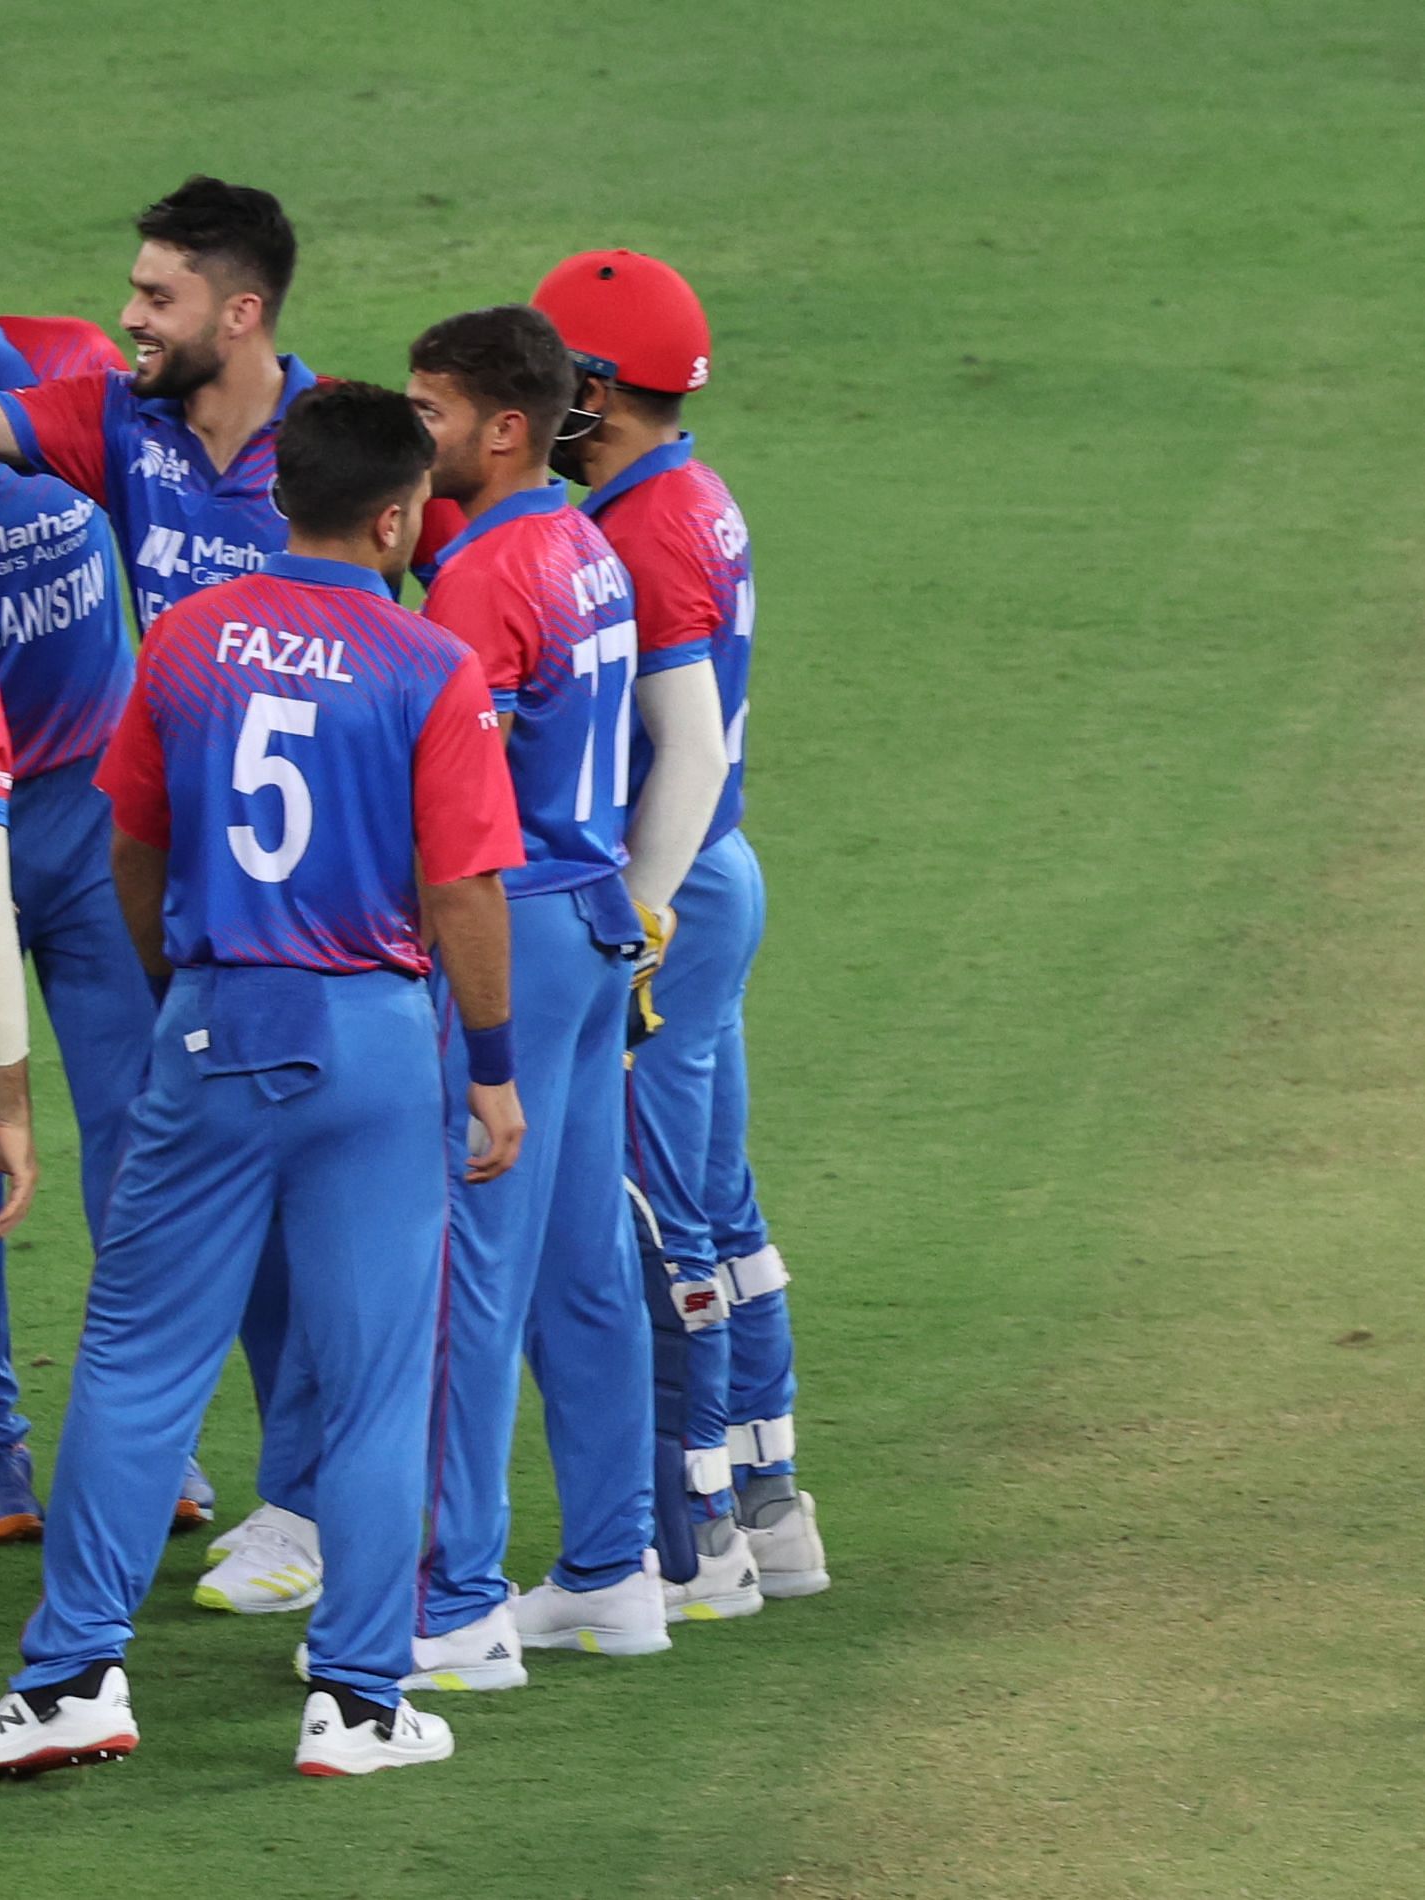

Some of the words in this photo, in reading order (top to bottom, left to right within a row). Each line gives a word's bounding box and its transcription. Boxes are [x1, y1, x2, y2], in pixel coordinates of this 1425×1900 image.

[216, 622, 354, 683] FAZAL
[572, 618, 638, 822] 77
[227, 692, 318, 883] 5
